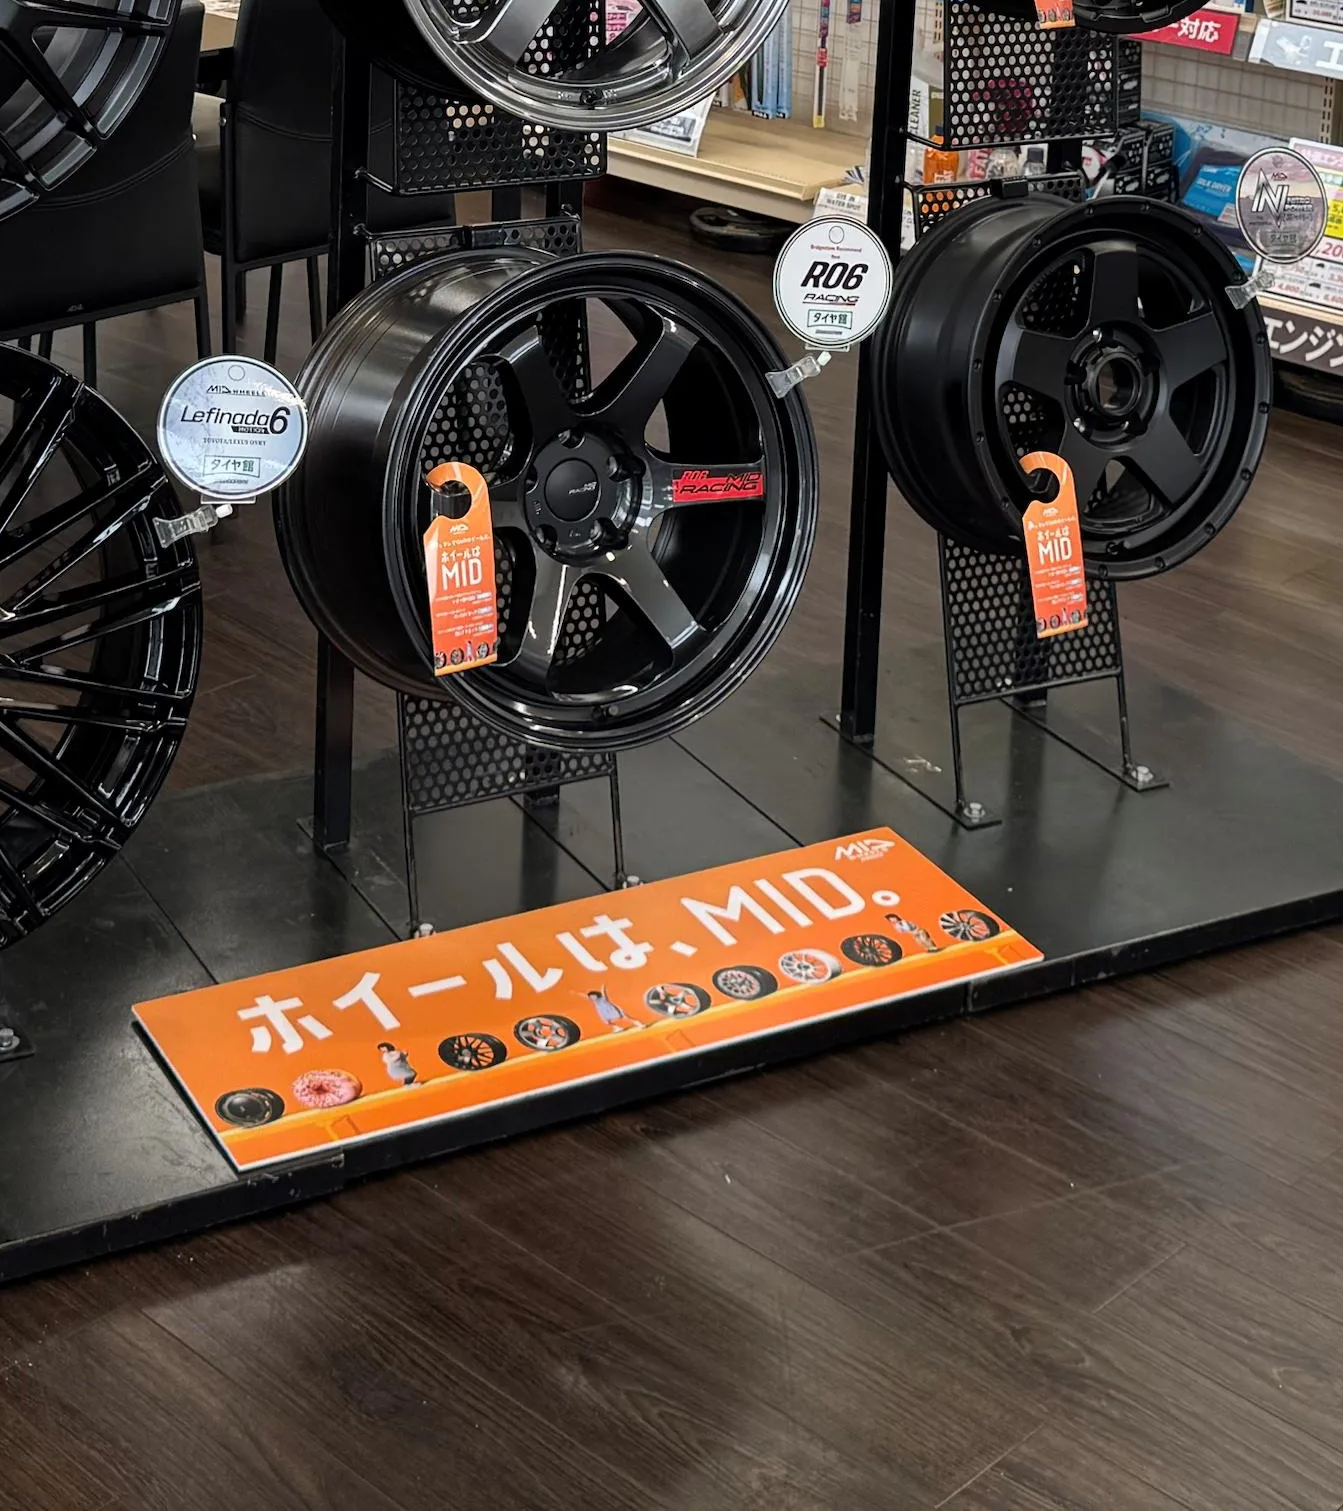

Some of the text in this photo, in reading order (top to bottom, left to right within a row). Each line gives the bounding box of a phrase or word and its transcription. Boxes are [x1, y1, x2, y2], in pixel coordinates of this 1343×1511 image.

[801, 261, 869, 290] R06
[804, 293, 859, 303] RACING
[814, 313, 847, 324] タイヤ館
[211, 459, 254, 472] タイヤ館
[440, 547, 481, 562] ホイールは
[1038, 537, 1072, 566] MID
[441, 558, 483, 591] MID
[237, 865, 901, 1058] ホイールは、MID。
